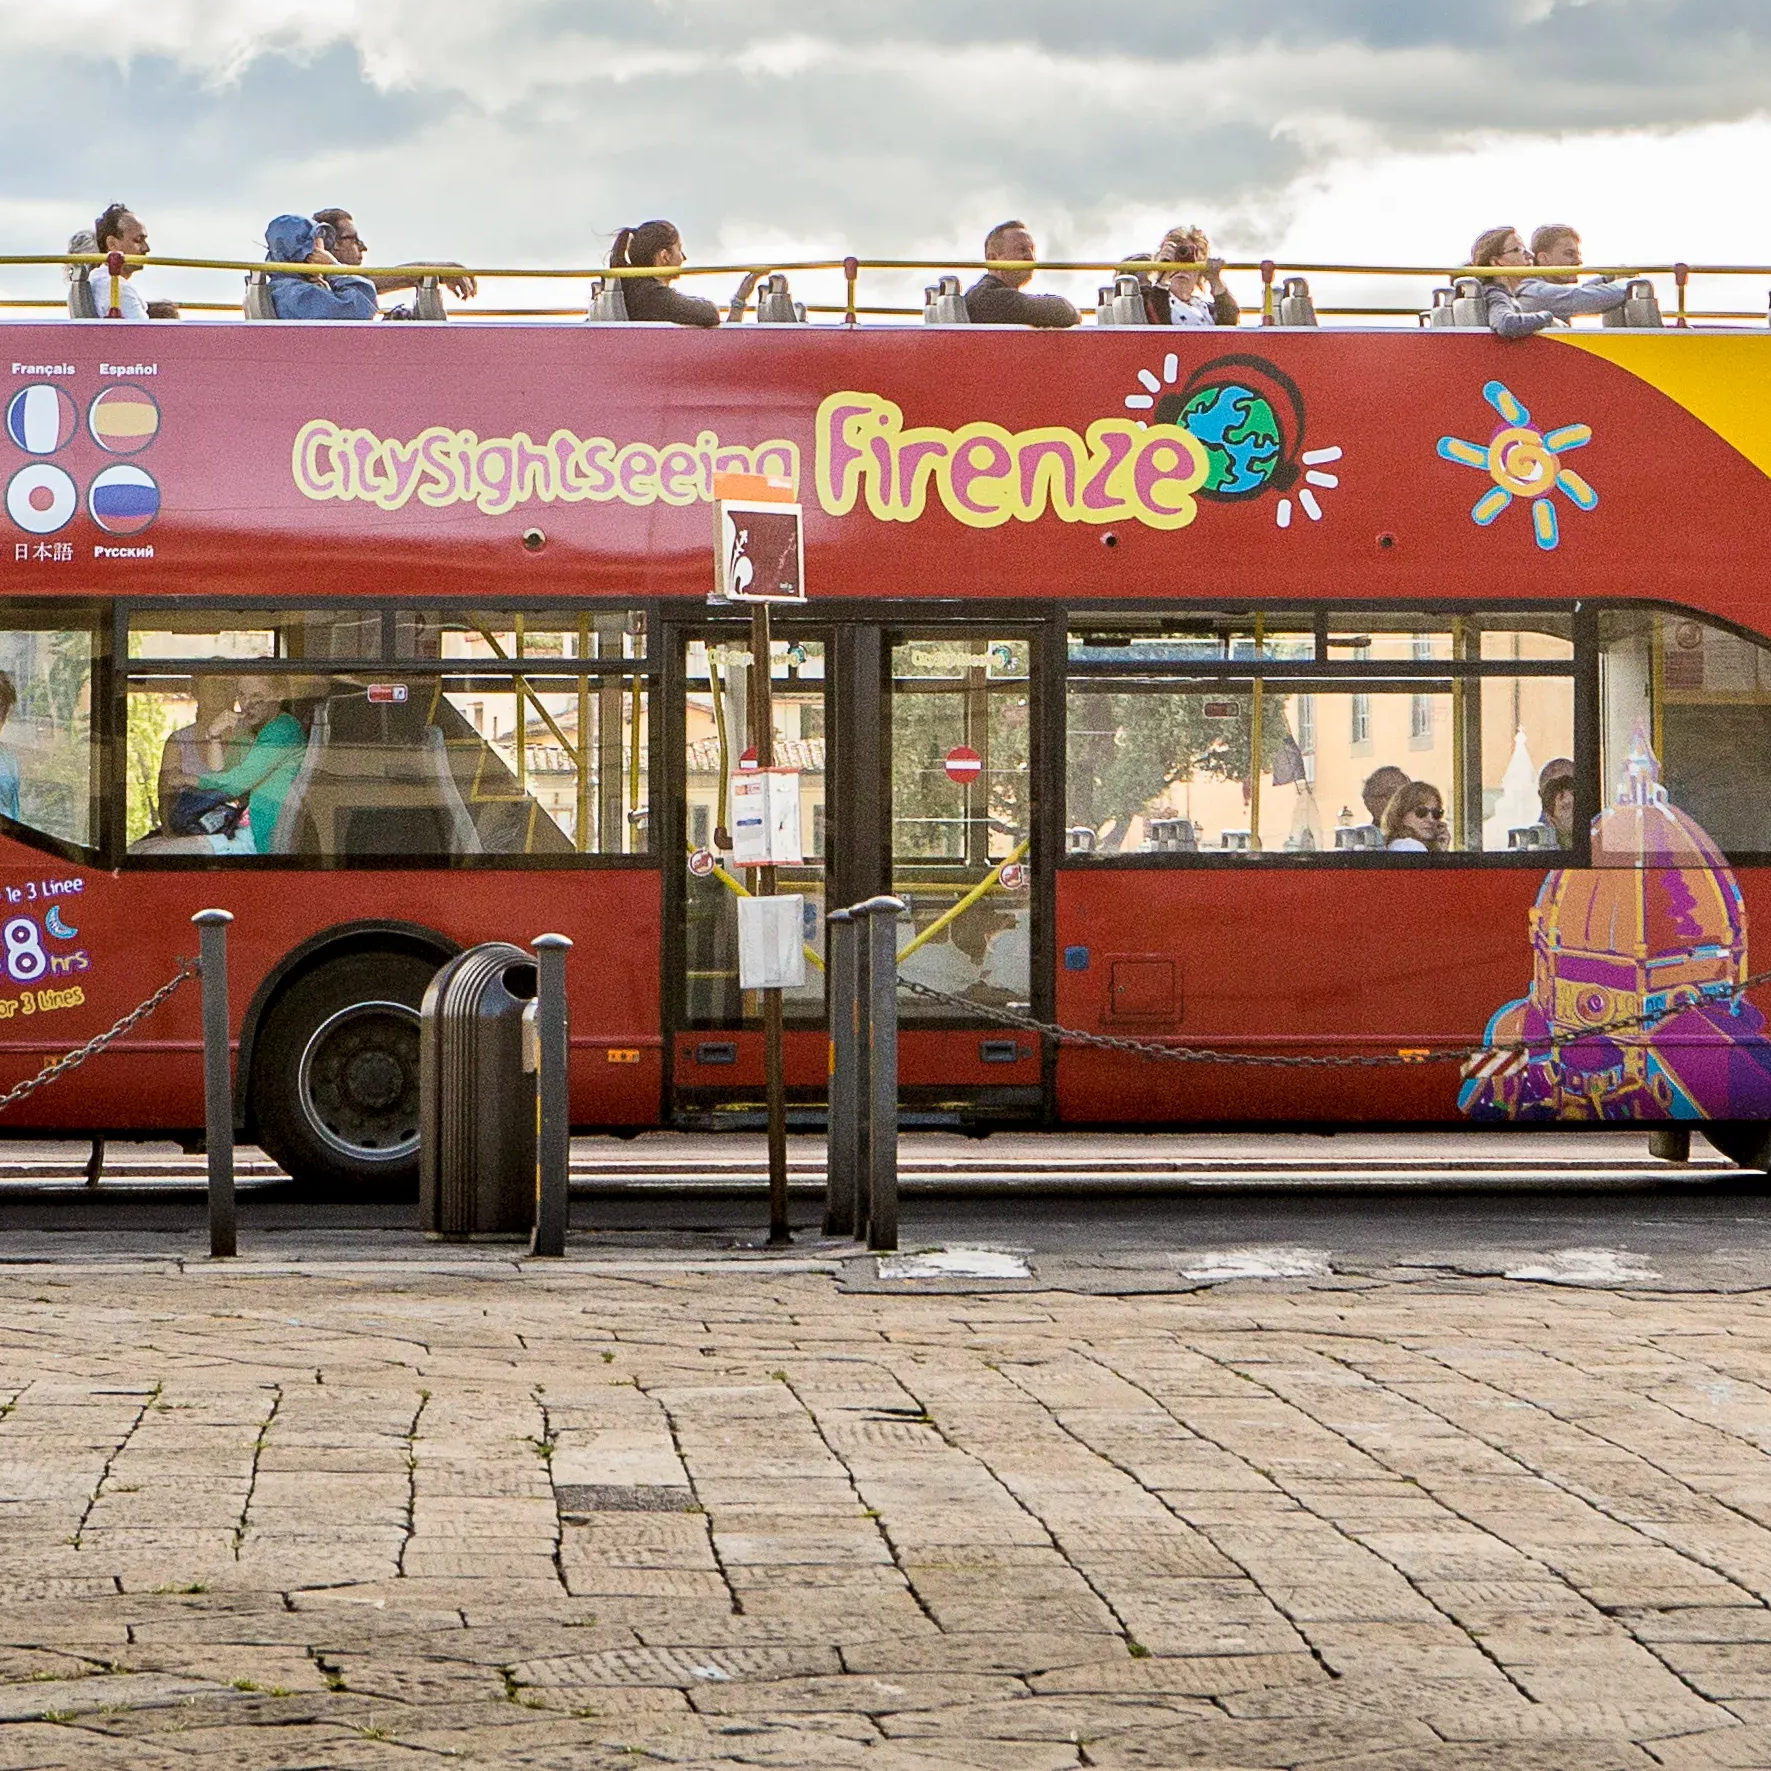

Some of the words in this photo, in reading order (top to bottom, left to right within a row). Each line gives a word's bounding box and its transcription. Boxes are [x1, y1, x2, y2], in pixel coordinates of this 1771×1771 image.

[11, 362, 76, 378] Français
[99, 362, 158, 378] Español
[819, 395, 1205, 524] Firenze
[14, 542, 74, 563] 日本語
[6, 886, 22, 903] le
[27, 882, 37, 899] 3
[42, 878, 84, 897] Linee
[20, 992, 36, 1014] 3
[38, 986, 85, 1011] Lines
